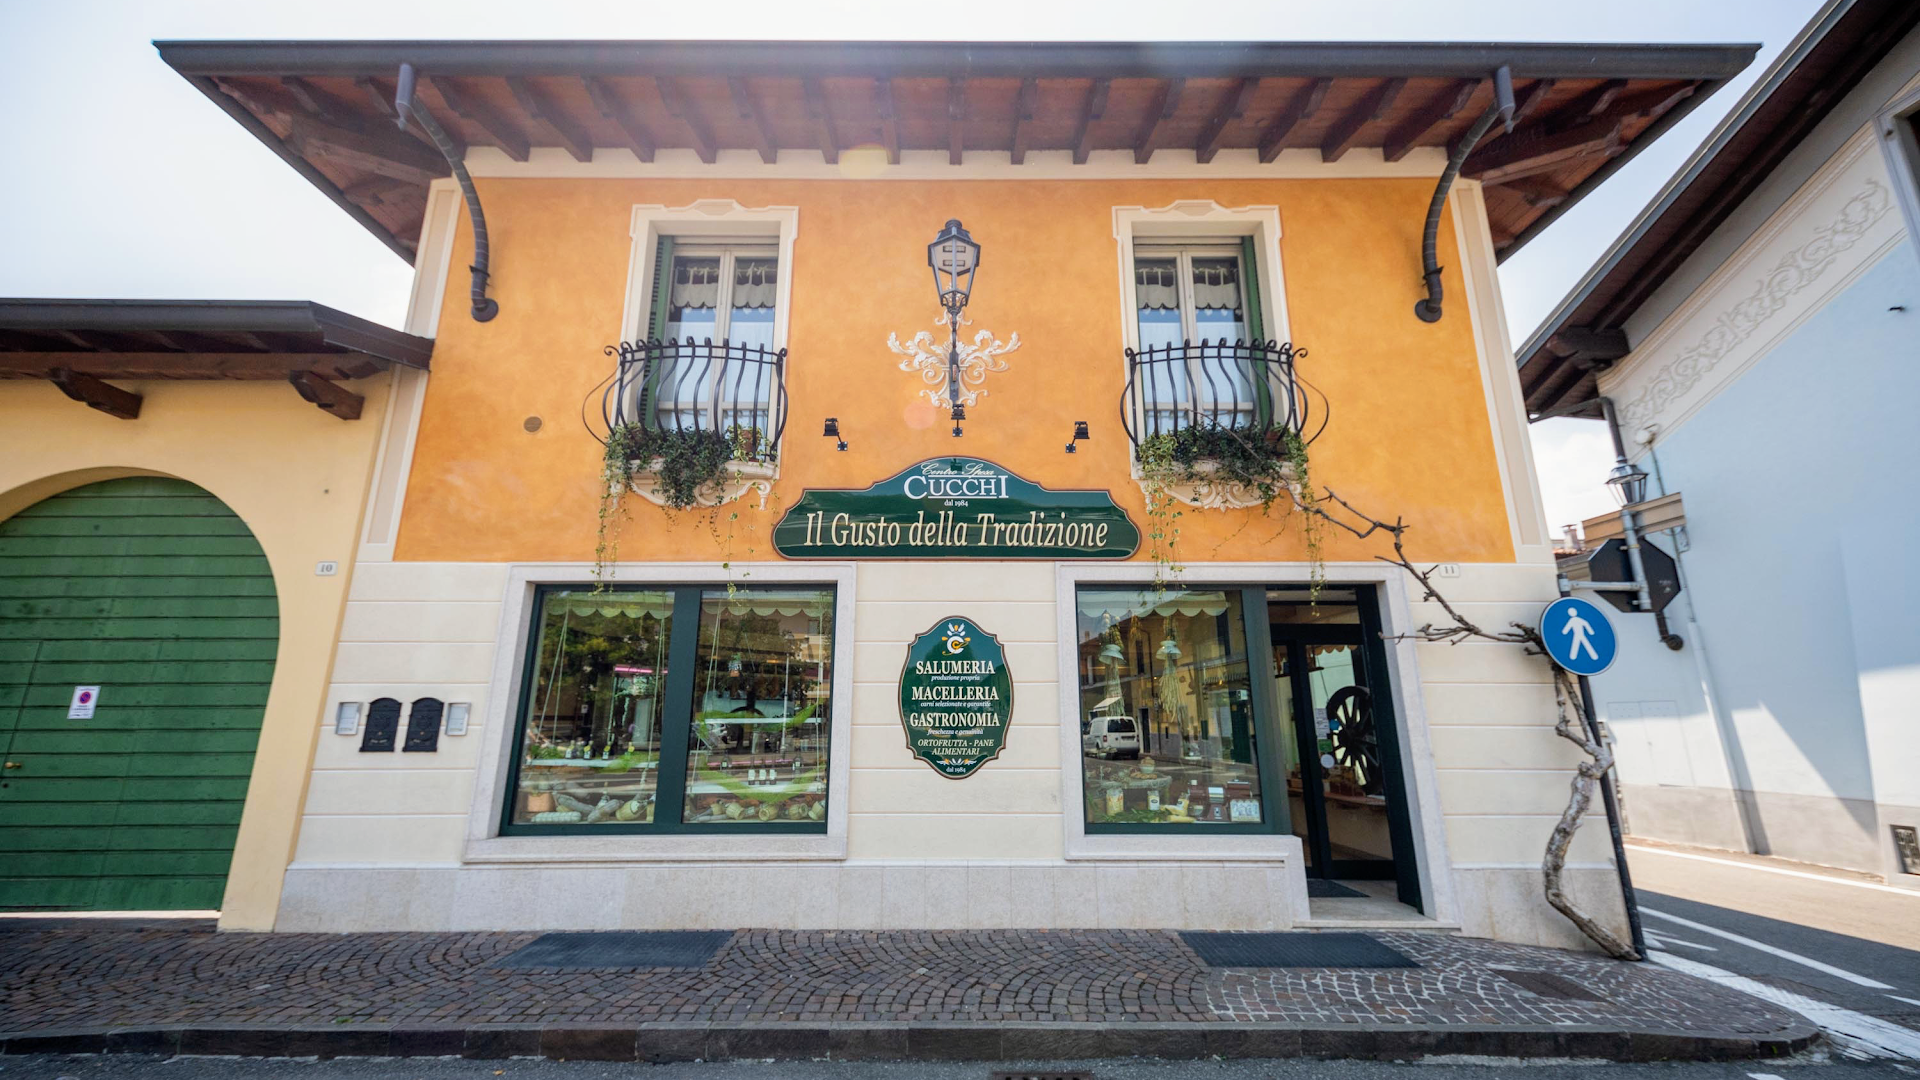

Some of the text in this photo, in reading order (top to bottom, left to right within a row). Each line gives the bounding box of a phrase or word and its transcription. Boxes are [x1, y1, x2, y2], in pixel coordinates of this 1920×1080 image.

[920, 462, 994, 478] Centro Spesa
[904, 475, 1009, 500] CUCCHI
[804, 511, 1108, 548] Il Gusto della Tradizione
[321, 564, 332, 572] 10
[1444, 566, 1454, 574] 11
[916, 660, 995, 674] SALUMERIA
[912, 686, 999, 700] MACELLERIA
[910, 712, 1000, 727] GASTRONOMIA
